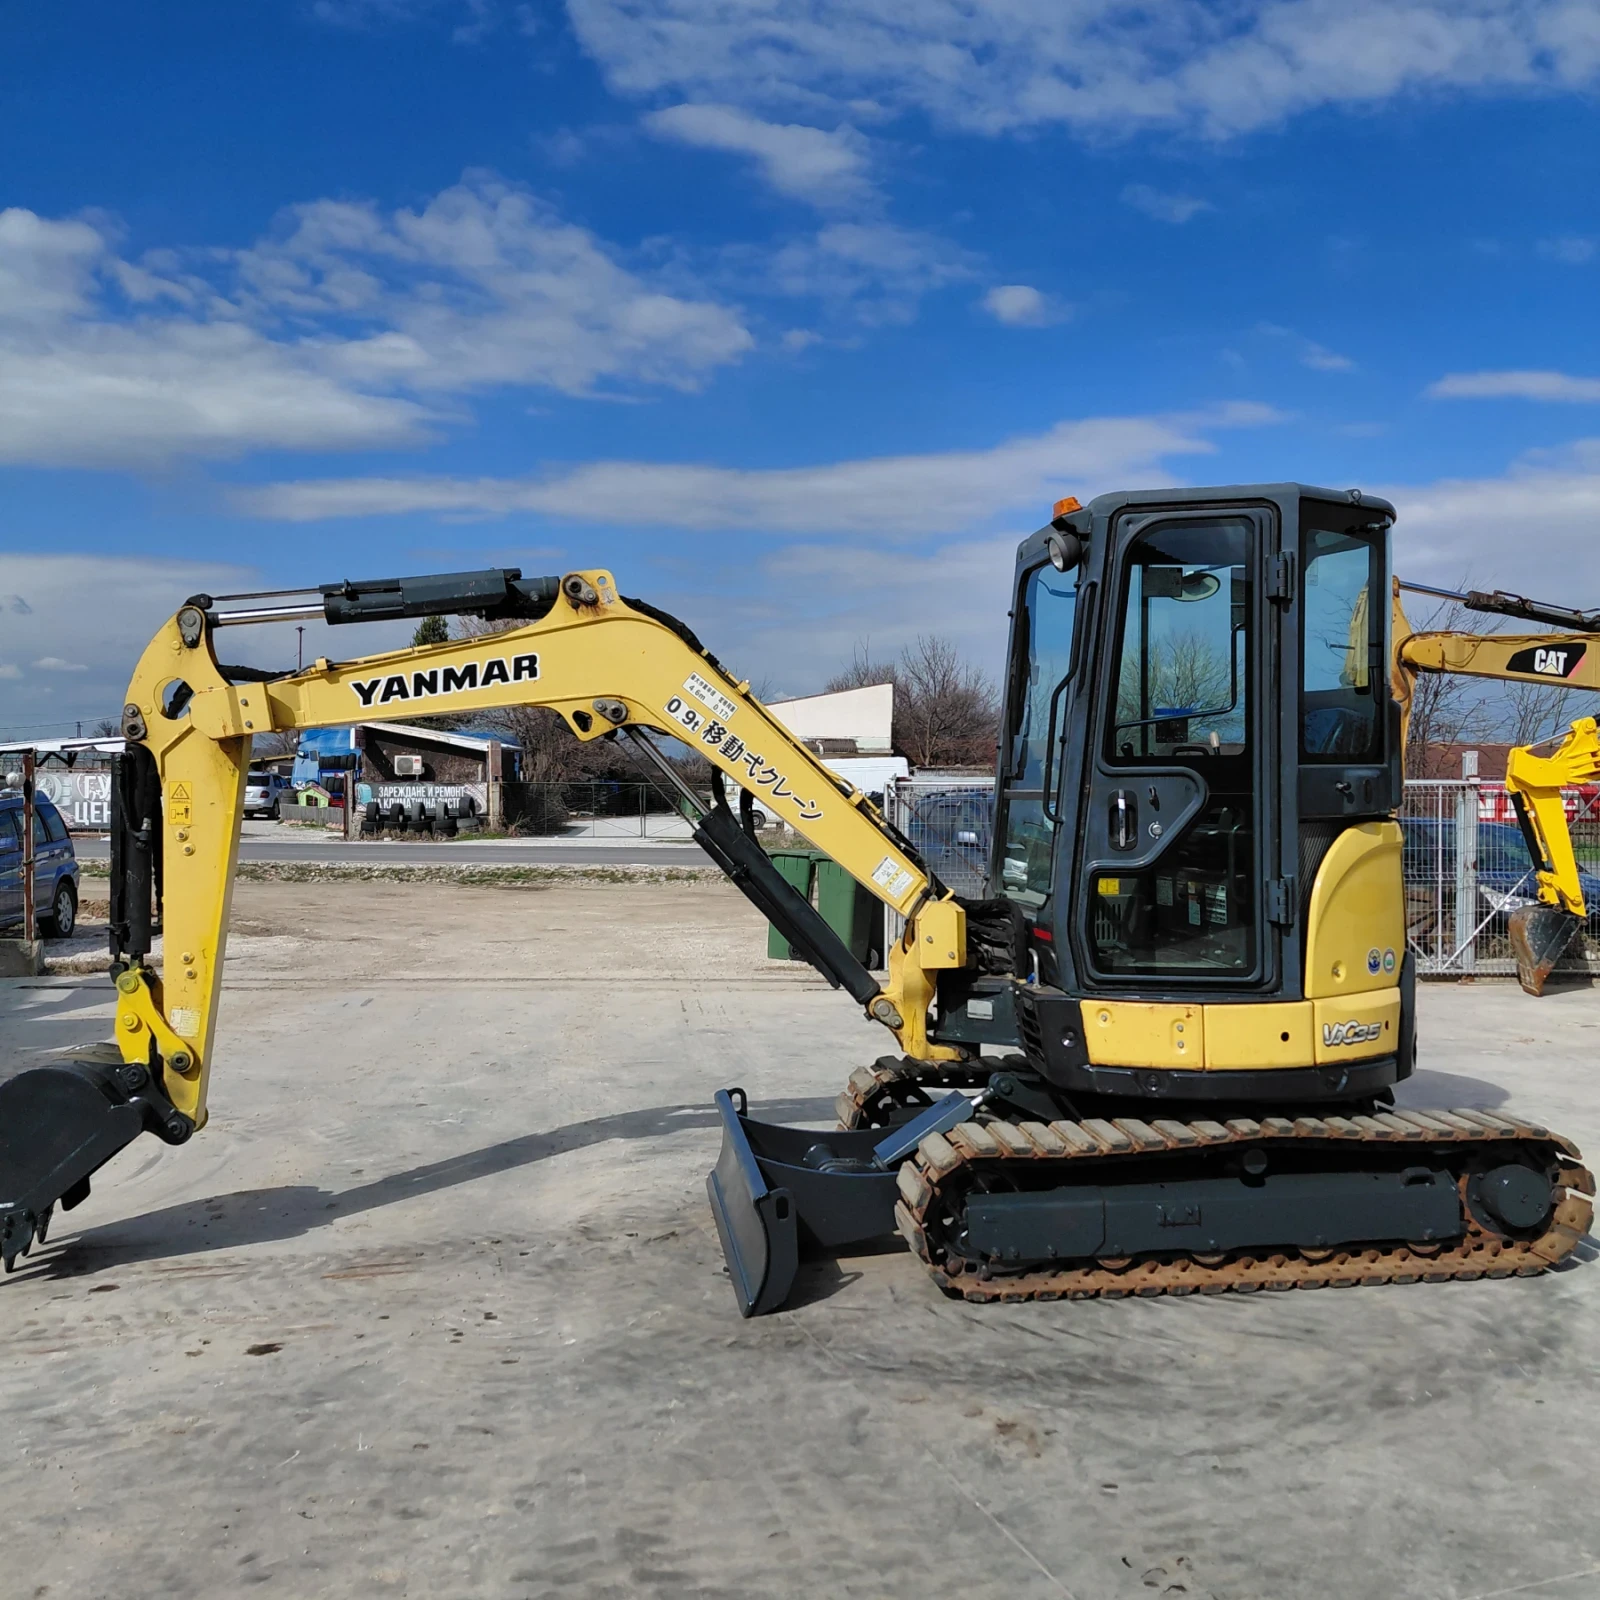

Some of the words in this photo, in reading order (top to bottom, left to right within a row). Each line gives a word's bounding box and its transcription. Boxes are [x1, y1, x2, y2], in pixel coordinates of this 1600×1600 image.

[1534, 649, 1568, 675] CAT
[351, 654, 538, 707] YANMAR
[688, 684, 706, 701] 4.6m
[666, 698, 700, 732] 0.9t
[378, 786, 426, 798] ЗАРЕЖДАНЕ
[428, 786, 434, 797] И
[435, 786, 465, 798] РЕМОНТ
